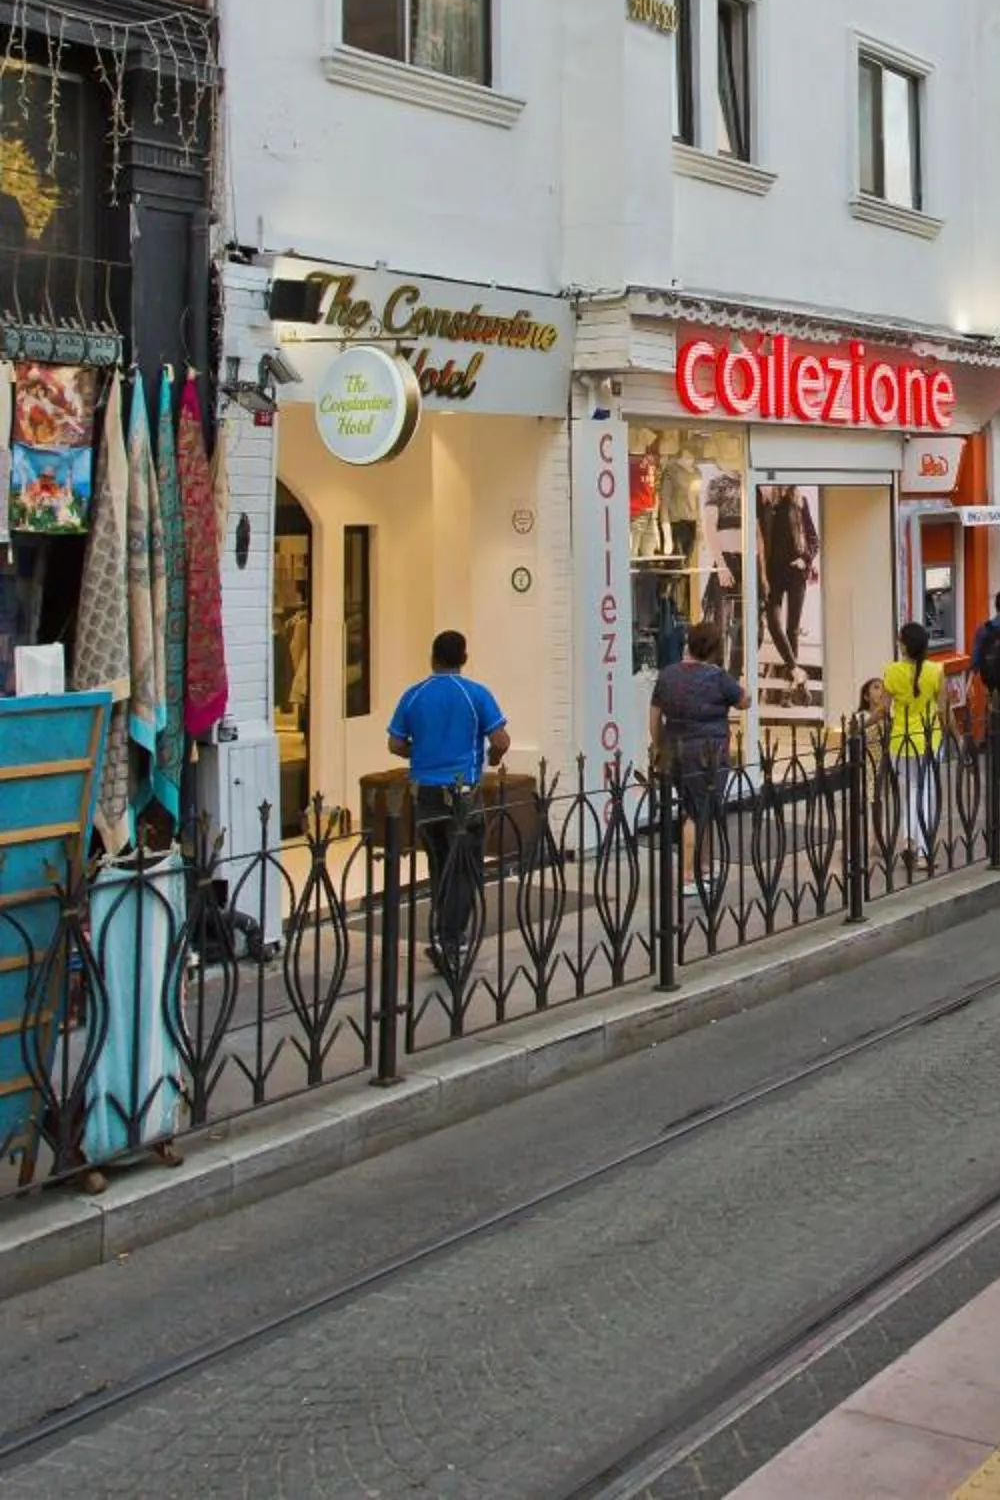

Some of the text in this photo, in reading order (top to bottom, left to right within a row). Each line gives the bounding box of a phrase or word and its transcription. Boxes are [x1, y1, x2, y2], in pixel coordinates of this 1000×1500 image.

[305, 270, 560, 353] The Constantine
[675, 331, 957, 430] collezione
